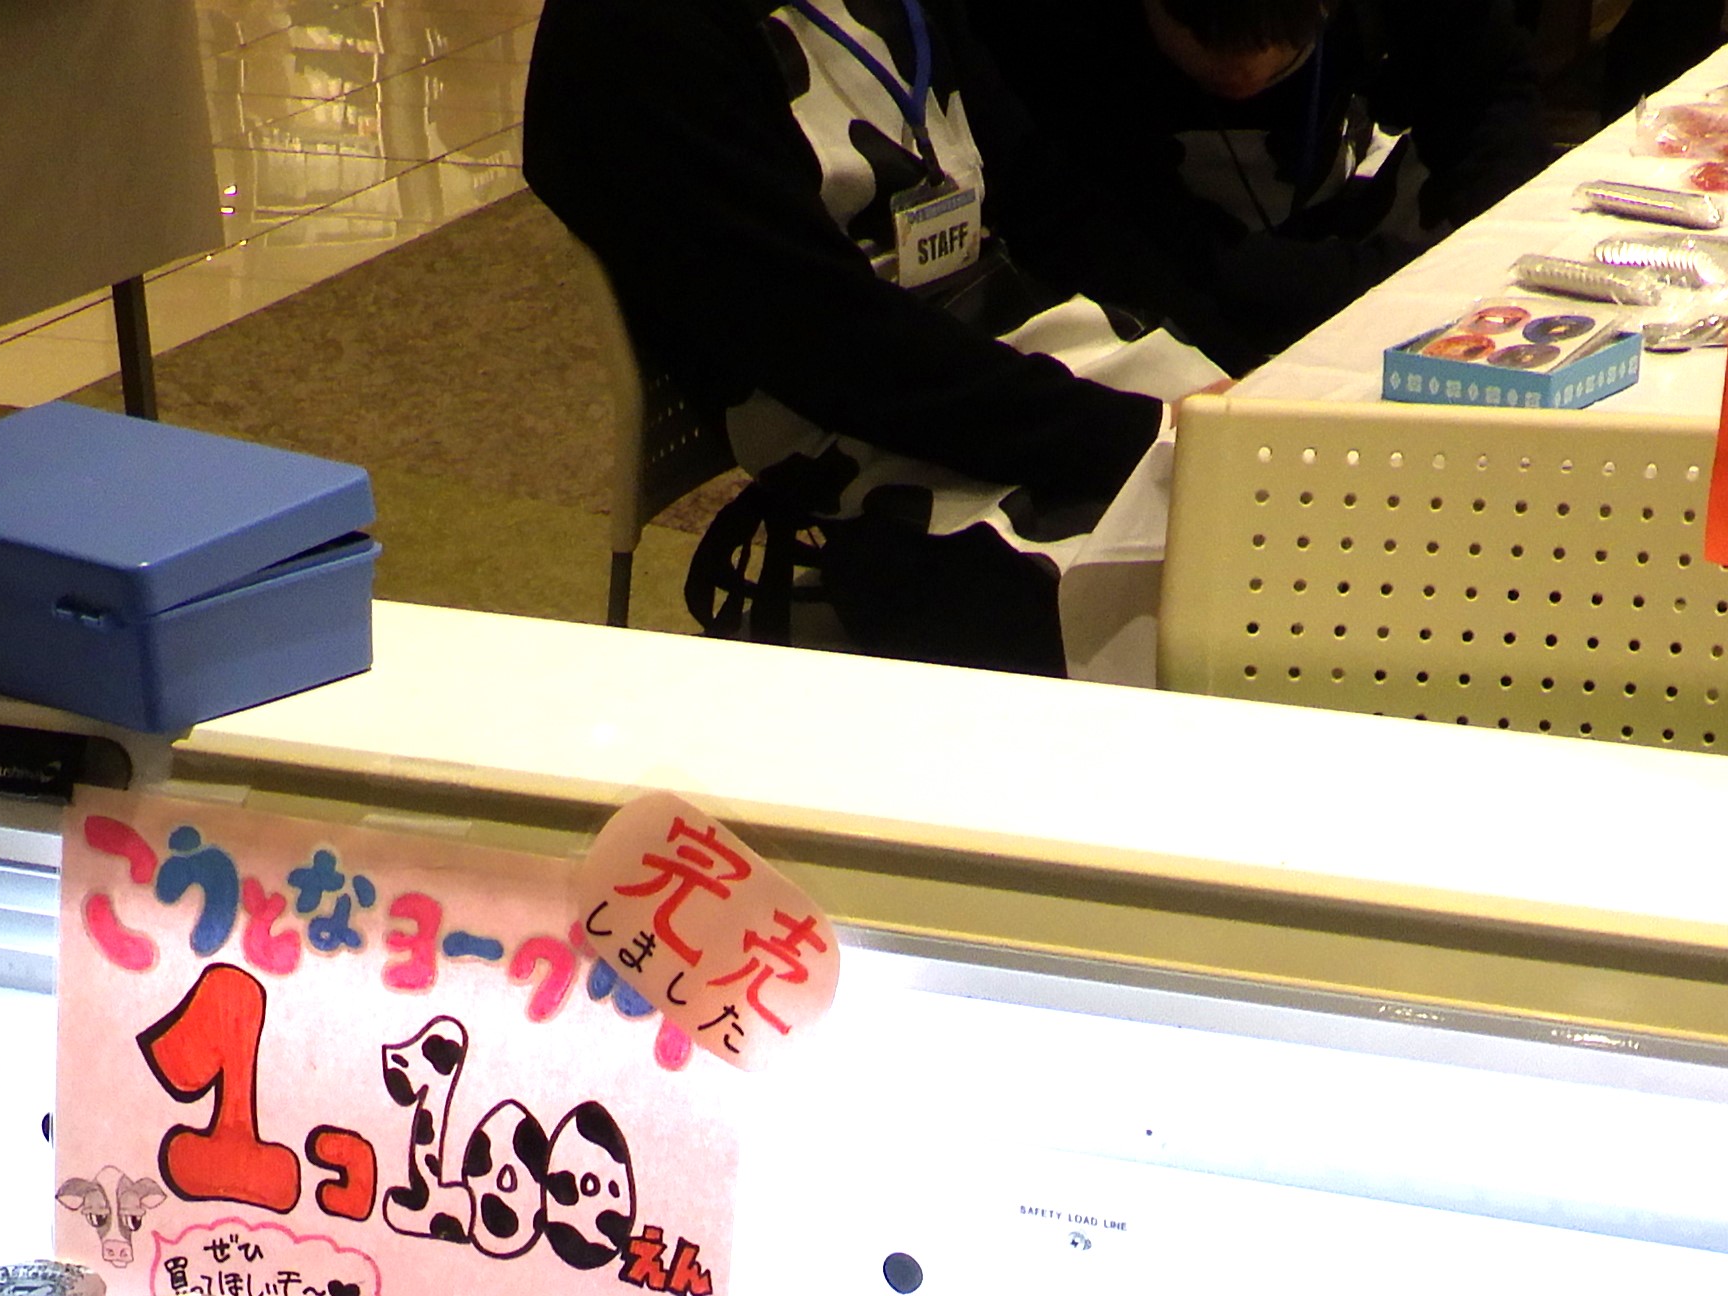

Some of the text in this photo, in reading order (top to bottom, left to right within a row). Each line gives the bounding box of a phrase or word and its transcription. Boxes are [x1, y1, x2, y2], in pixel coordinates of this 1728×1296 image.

[917, 221, 969, 265] STAFF
[613, 816, 830, 1035] 完売
[586, 900, 744, 1054] しました
[1020, 1205, 1062, 1220] SAFETY
[1068, 1213, 1098, 1227] LOAD
[204, 1234, 264, 1263] ぜひ
